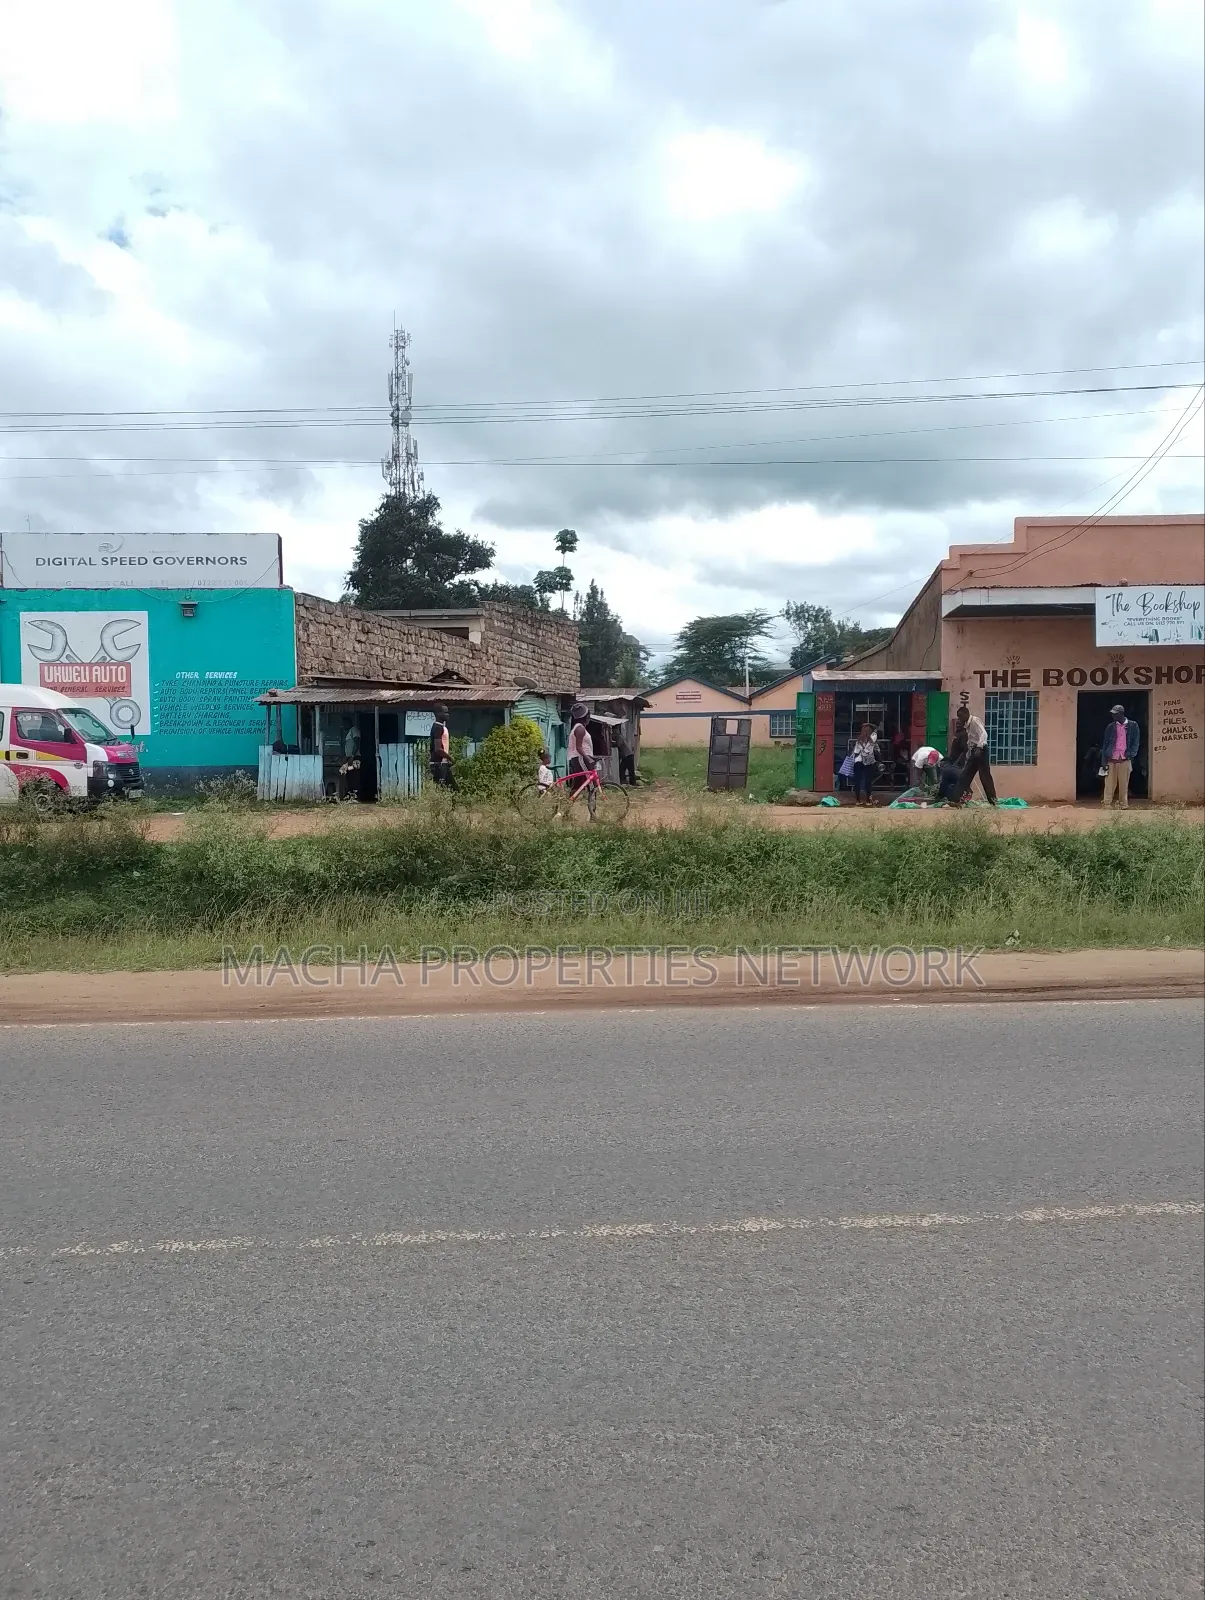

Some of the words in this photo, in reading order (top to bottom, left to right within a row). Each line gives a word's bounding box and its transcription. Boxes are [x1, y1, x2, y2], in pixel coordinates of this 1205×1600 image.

[35, 557, 97, 566] DIGITAL
[101, 556, 148, 566] SPEED
[152, 556, 248, 566] GOVERNORS
[1105, 591, 1132, 617] The
[1136, 590, 1201, 620] Bookshop
[92, 665, 127, 683] AUTO
[175, 671, 200, 679] OTHER
[204, 671, 238, 679] SERVICES
[973, 668, 1031, 688] THE
[1163, 708, 1185, 716] PADS
[1161, 726, 1194, 734] CHALKS
[1161, 733, 1199, 742] MARKERS
